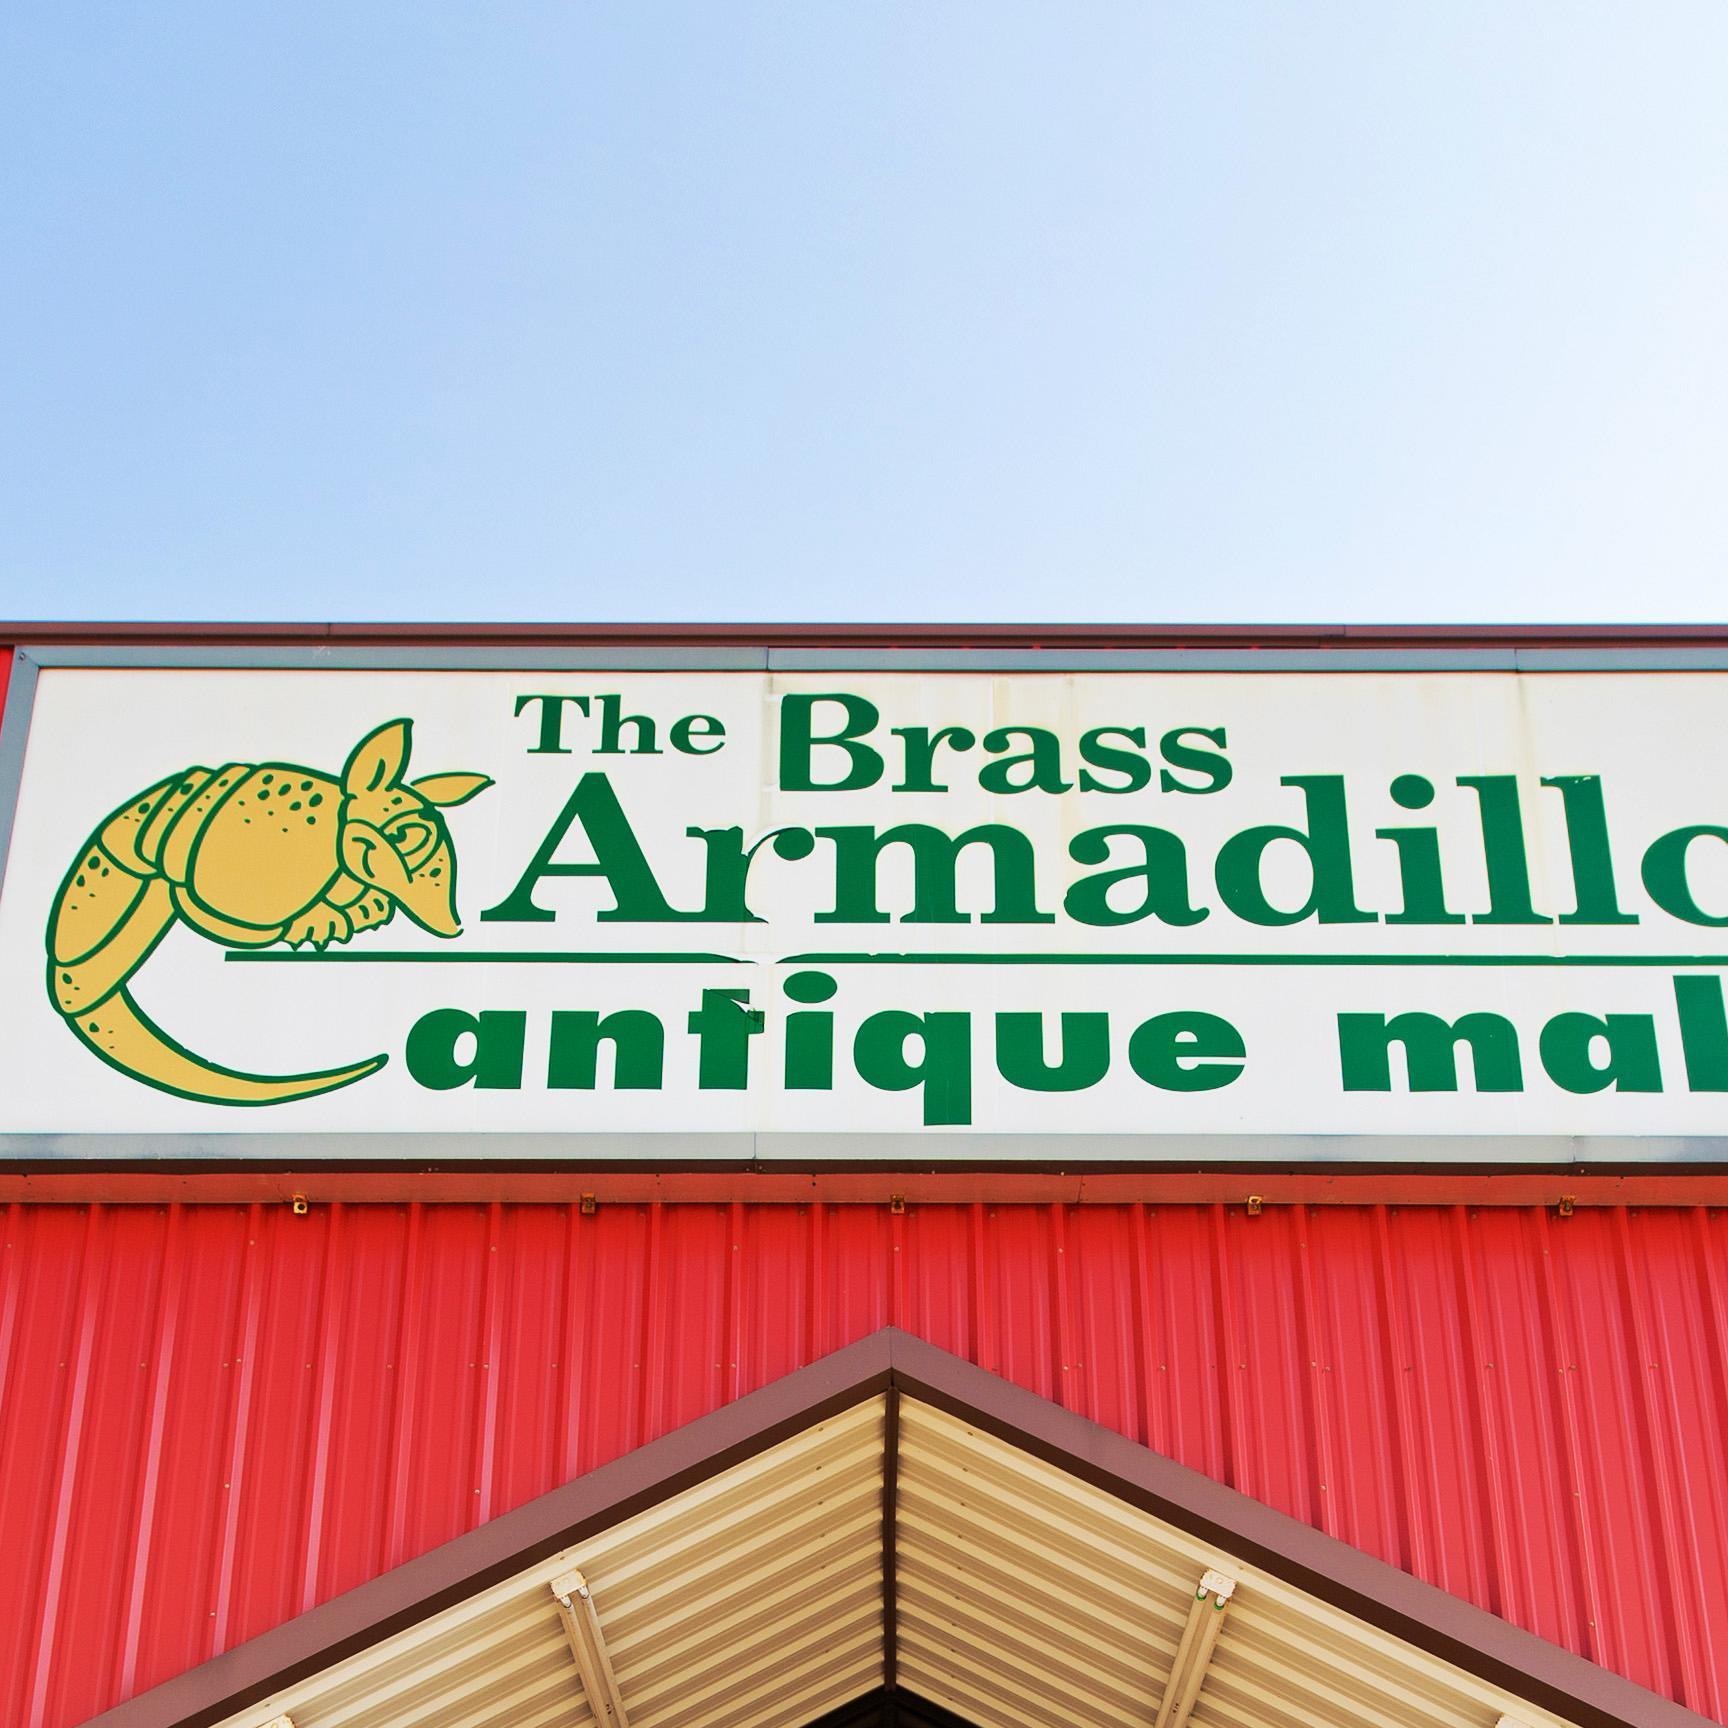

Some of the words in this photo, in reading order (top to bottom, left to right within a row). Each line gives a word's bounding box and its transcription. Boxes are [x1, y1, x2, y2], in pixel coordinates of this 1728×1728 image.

[514, 693, 726, 755] The
[779, 692, 1233, 794] Brass
[405, 970, 1247, 1126] antique
